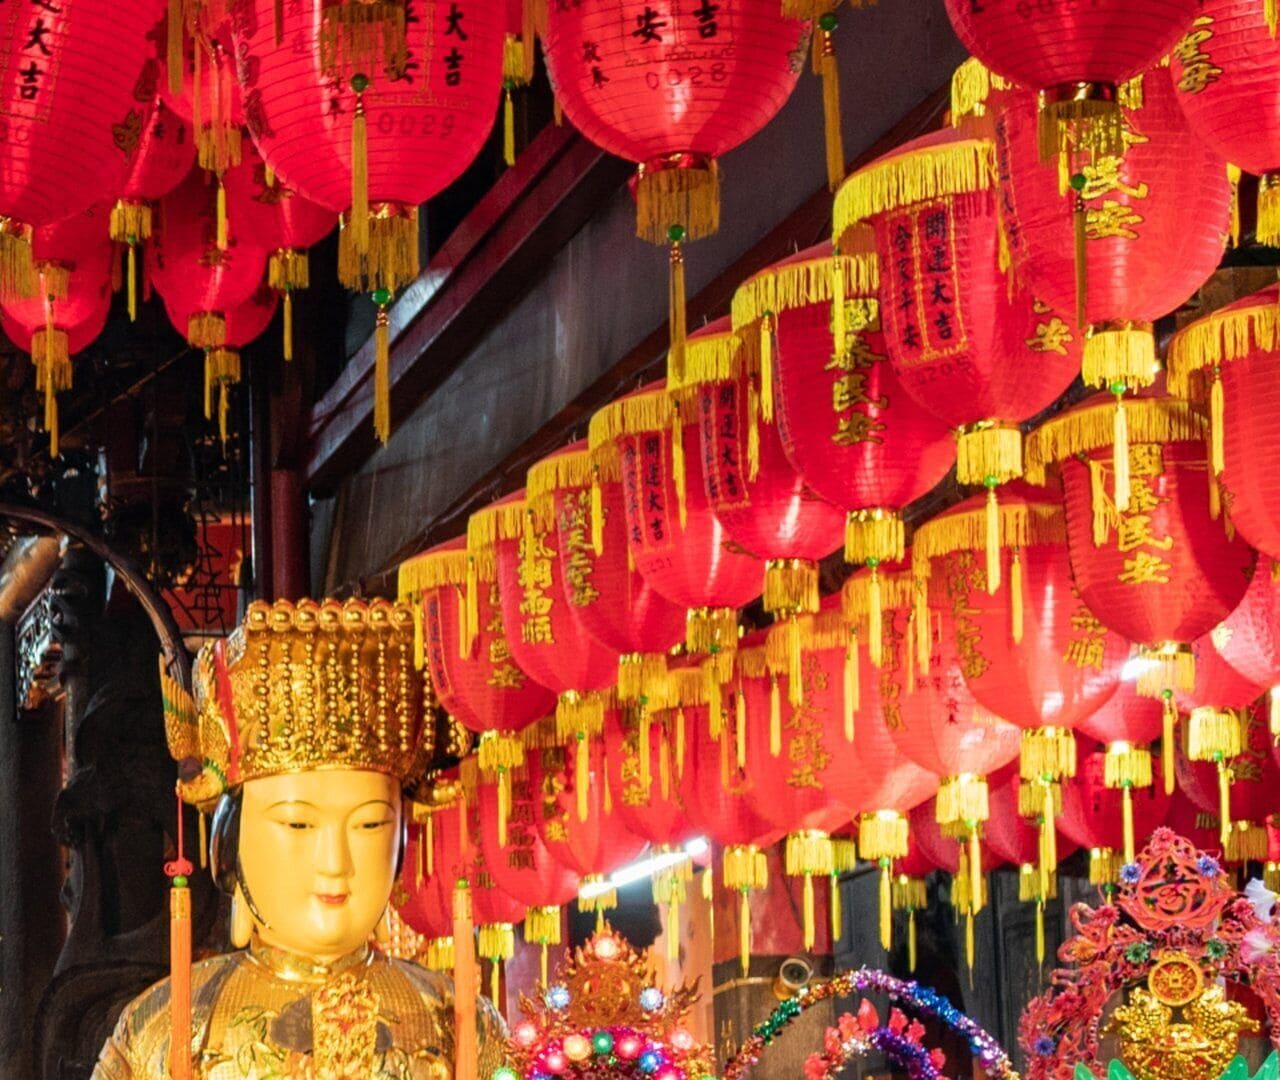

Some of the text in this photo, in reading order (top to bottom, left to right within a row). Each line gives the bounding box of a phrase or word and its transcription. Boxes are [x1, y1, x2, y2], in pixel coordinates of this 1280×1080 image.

[443, 3, 469, 87] 大吉
[632, 6, 668, 44] 安
[693, 0, 719, 40] 吉
[644, 61, 728, 90] 0028
[376, 112, 457, 138] 0029
[894, 224, 920, 349] 合家平安
[926, 211, 953, 342] 開運大吉
[718, 385, 740, 498] 開運大吉
[643, 436, 665, 541] 開運大吉
